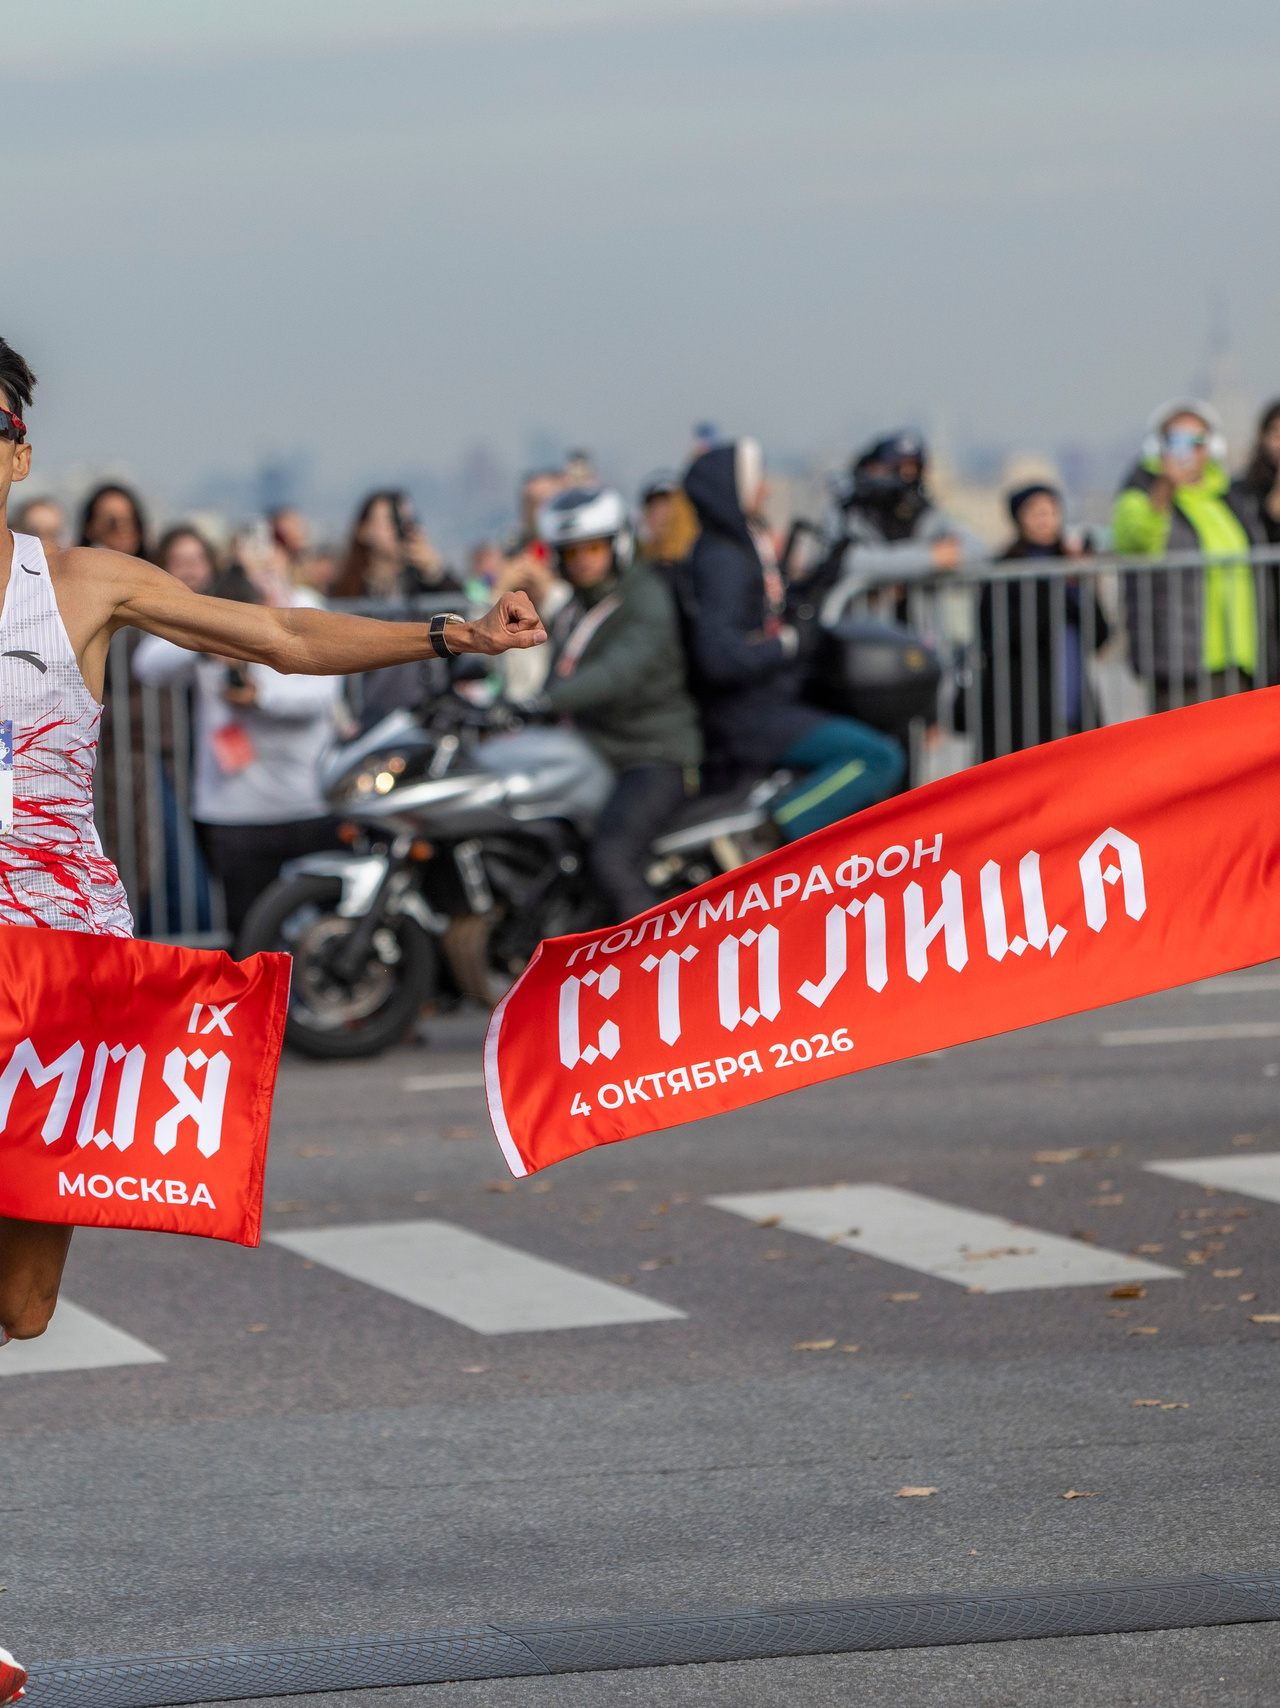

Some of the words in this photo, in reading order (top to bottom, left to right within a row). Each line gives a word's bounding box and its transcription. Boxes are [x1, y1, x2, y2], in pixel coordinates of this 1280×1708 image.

[566, 833, 943, 967] ПОЛУМАРАФОН
[558, 826, 1147, 1070] СТОЛИЦА
[187, 1002, 238, 1037] IX
[569, 1092, 592, 1117] 4
[596, 1049, 763, 1110] ОКТЯБРЯ
[774, 1028, 855, 1070] 2026
[58, 1171, 217, 1210] МОСКВА
